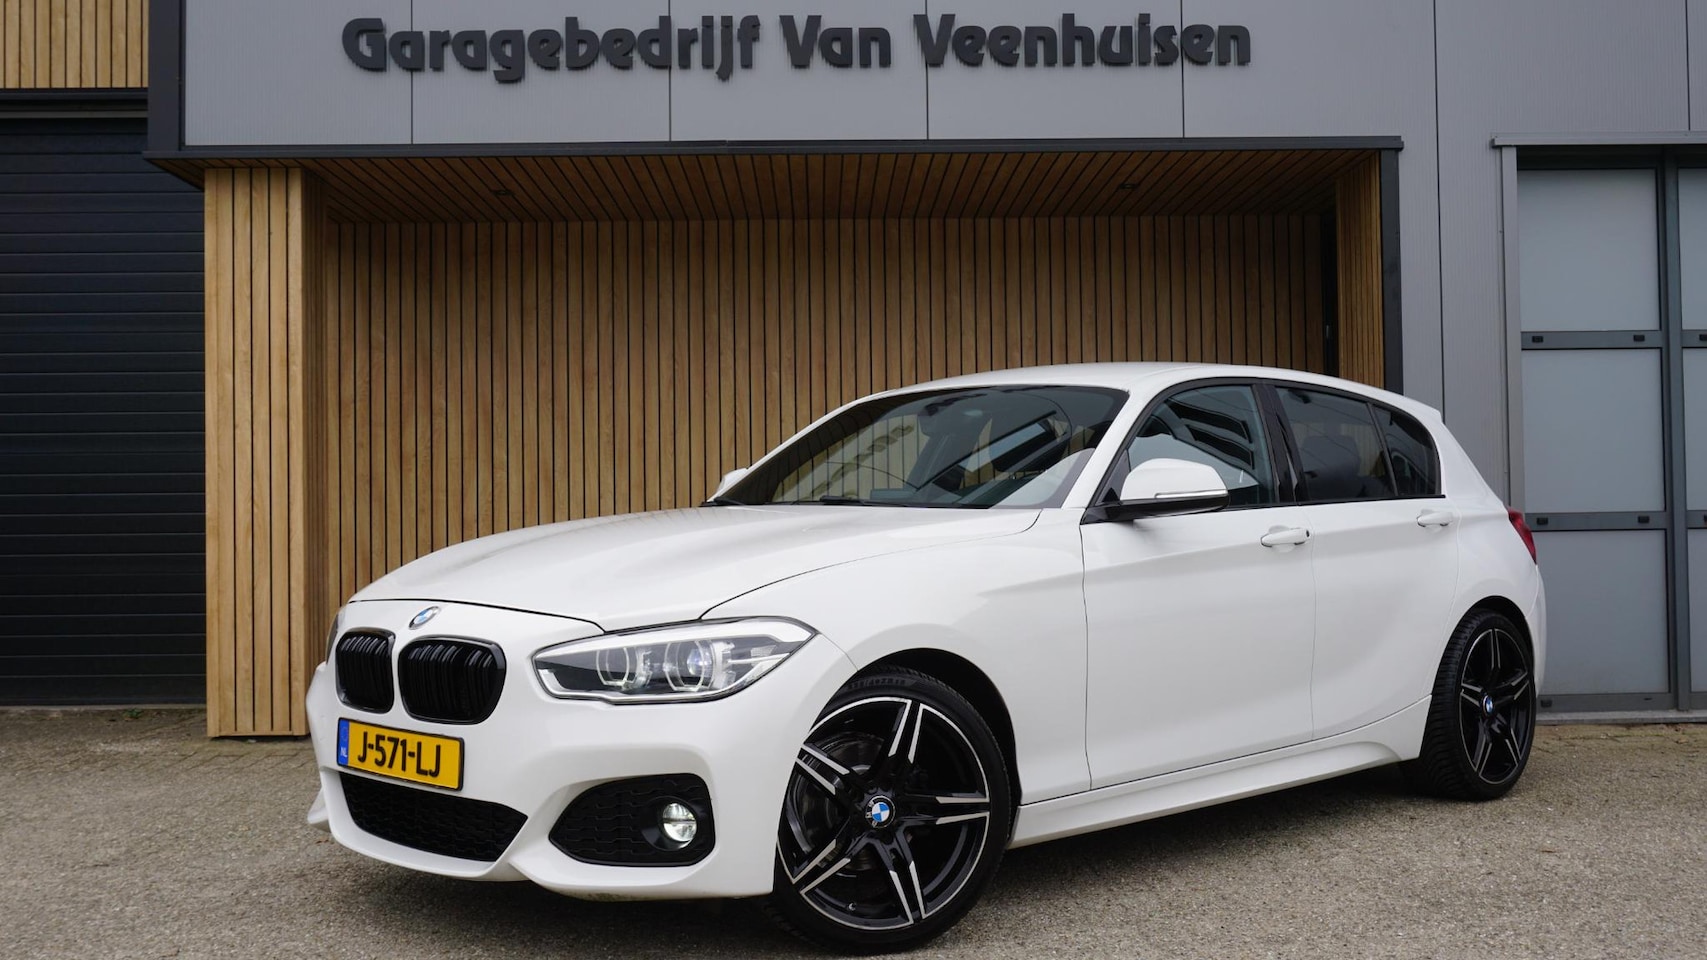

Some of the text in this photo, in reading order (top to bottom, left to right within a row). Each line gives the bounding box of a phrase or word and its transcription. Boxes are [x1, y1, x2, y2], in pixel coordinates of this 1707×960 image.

[341, 13, 1251, 83] Garagebedrijf Van Veenhuisen
[340, 746, 348, 758] NL
[358, 731, 441, 778] J-571-LJ
